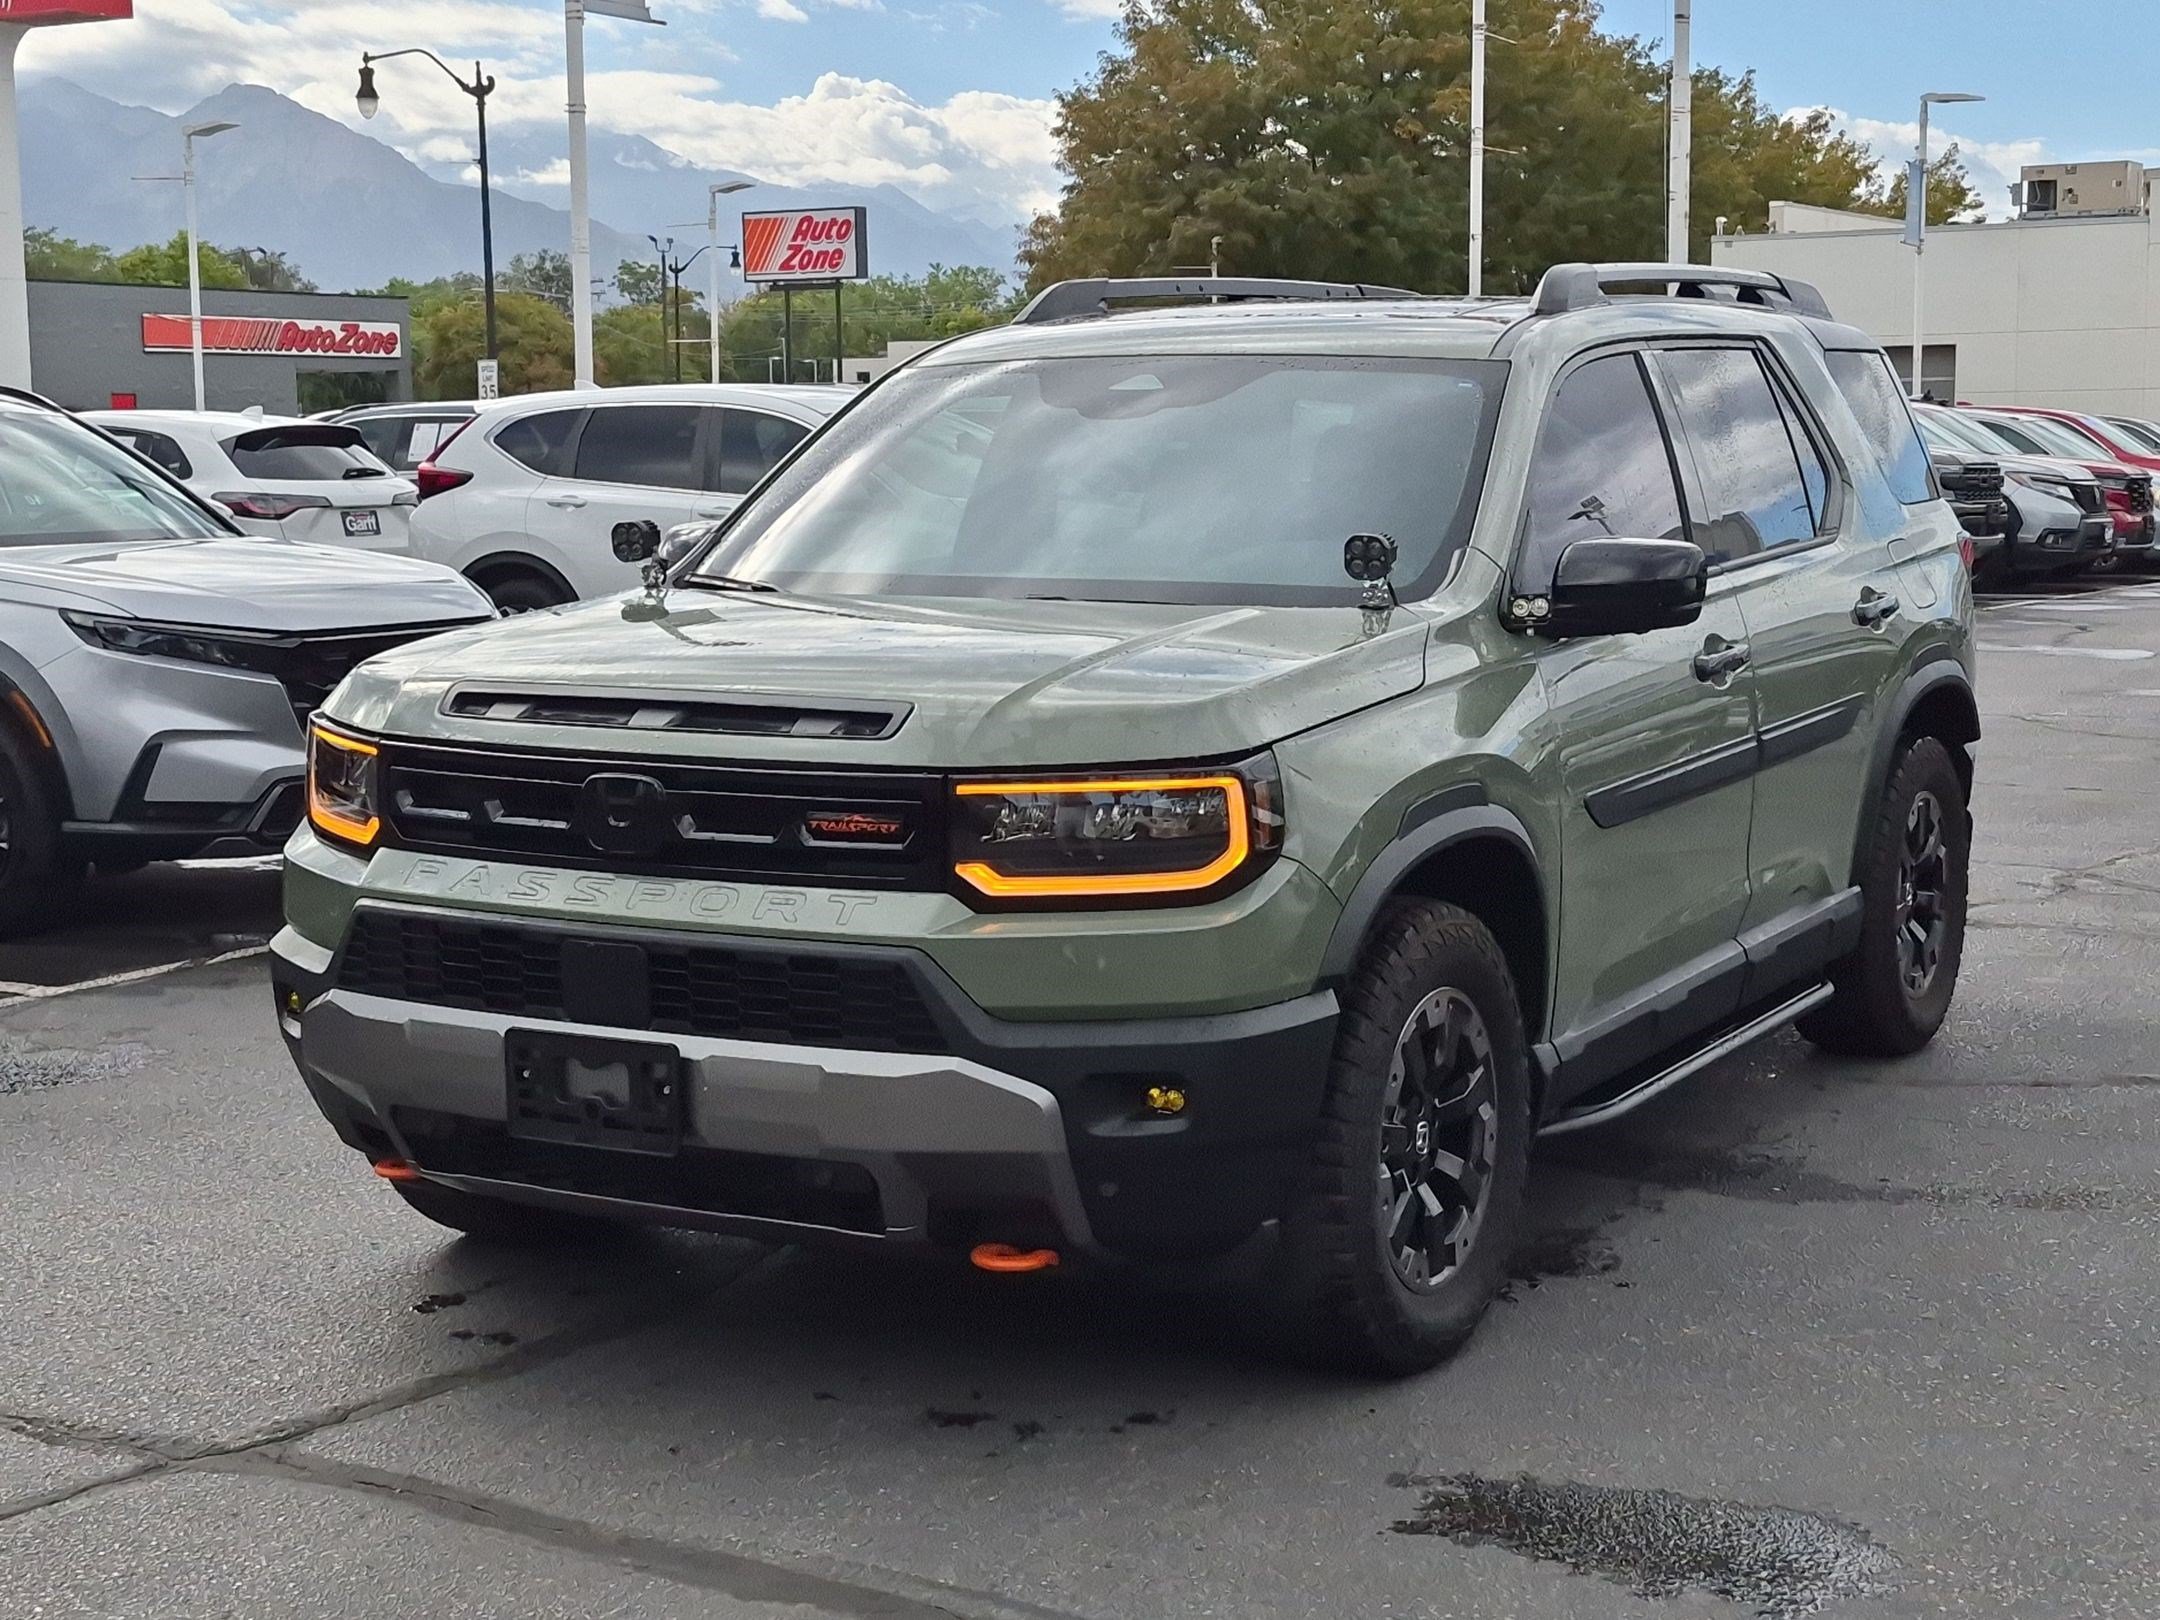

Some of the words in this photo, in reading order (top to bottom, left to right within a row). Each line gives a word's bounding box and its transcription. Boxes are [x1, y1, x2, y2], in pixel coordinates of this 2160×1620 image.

[790, 214, 852, 243] Auto
[778, 243, 845, 271] Zone
[275, 321, 399, 355] AutoZone
[480, 384, 497, 400] 35
[807, 819, 900, 834] TRAILSPORT
[403, 858, 878, 926] PASSPORT
